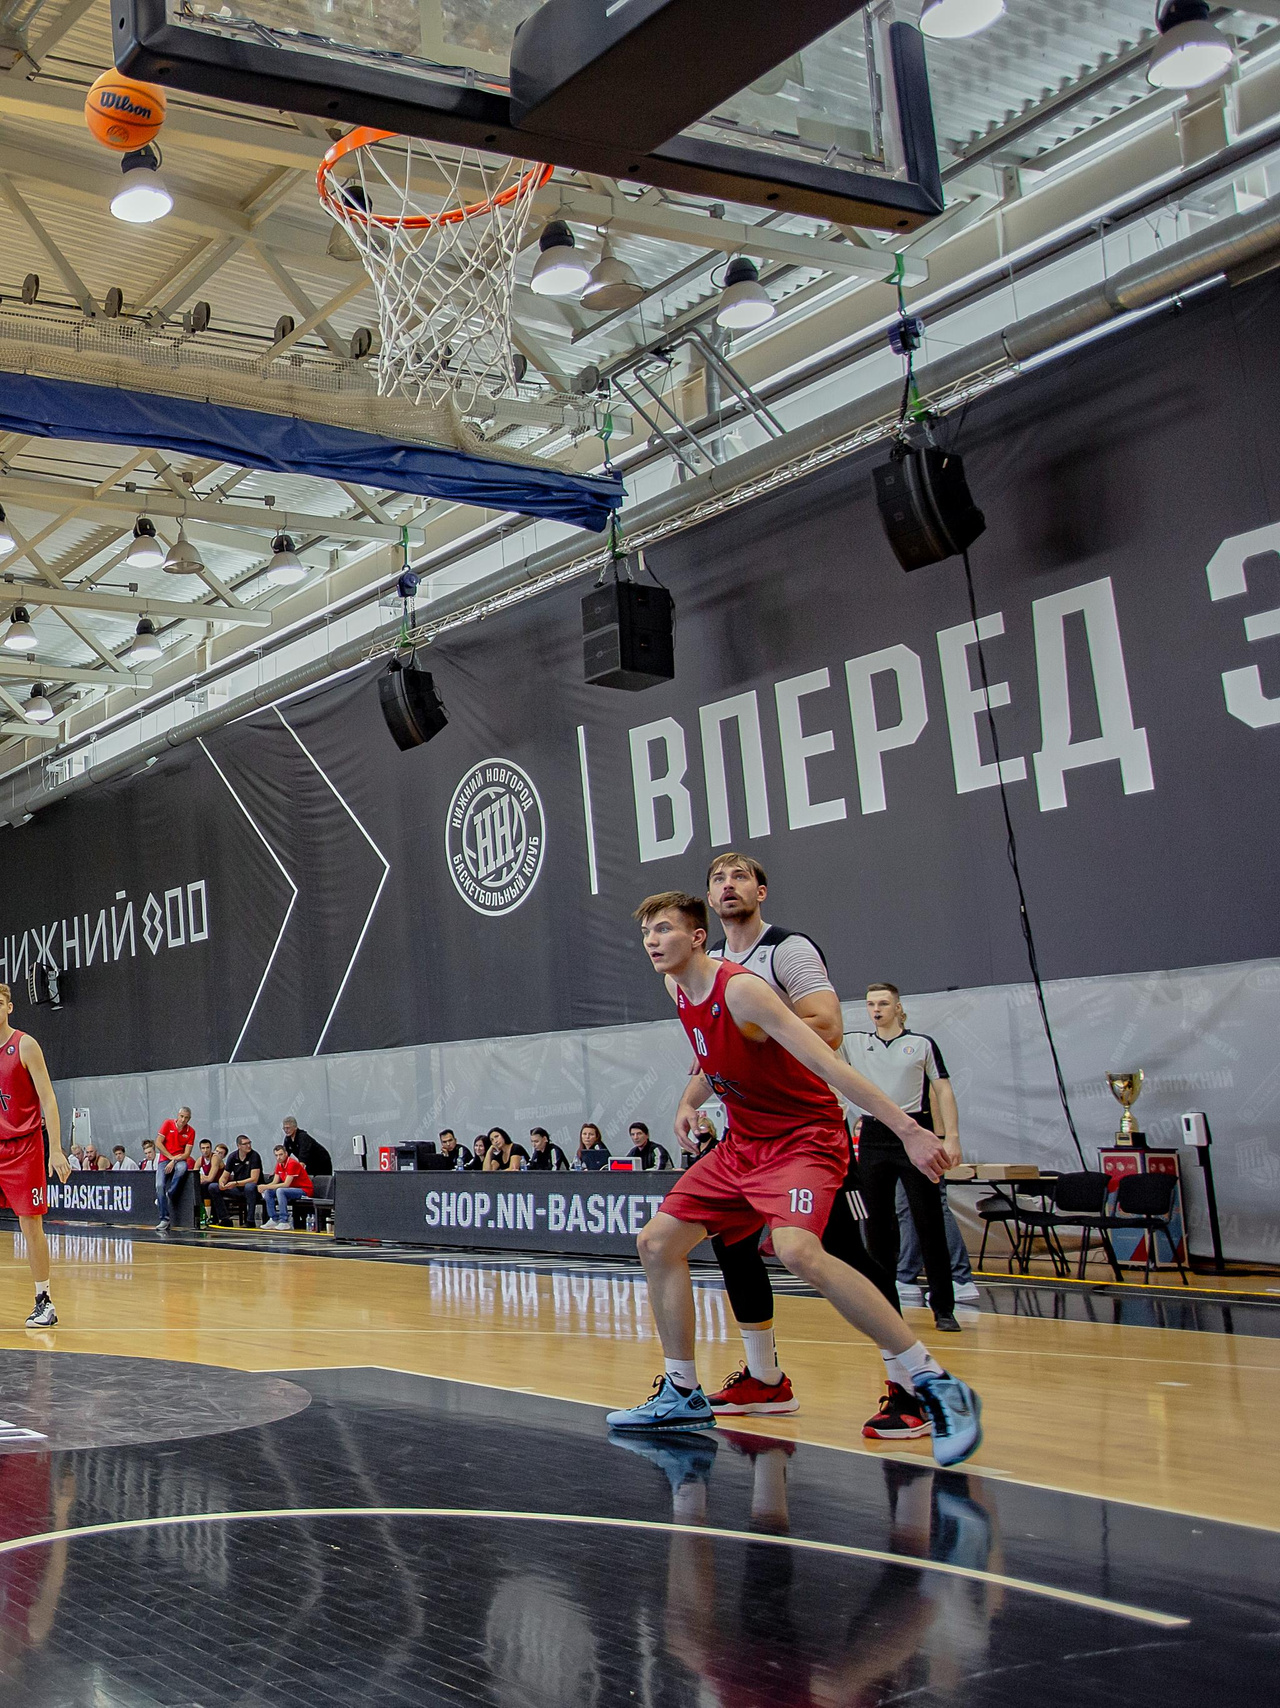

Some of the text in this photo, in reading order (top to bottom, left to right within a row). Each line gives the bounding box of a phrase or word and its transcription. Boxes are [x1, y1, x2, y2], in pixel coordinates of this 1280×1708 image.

[100, 91, 152, 119] Wilson
[628, 576, 1156, 864] ВПЕРЕД
[452, 767, 534, 829] НИЖНИЙ НОВГОРОД
[452, 836, 540, 907] БАСКЕТБОЛЬНЫЙ КЛУБ
[141, 879, 209, 956] 800
[692, 1027, 708, 1057] 18
[380, 1152, 389, 1170] 5
[31, 1186, 44, 1206] 34
[424, 1189, 664, 1235] SHOP.NN-BASKET
[787, 1187, 815, 1215] 18
